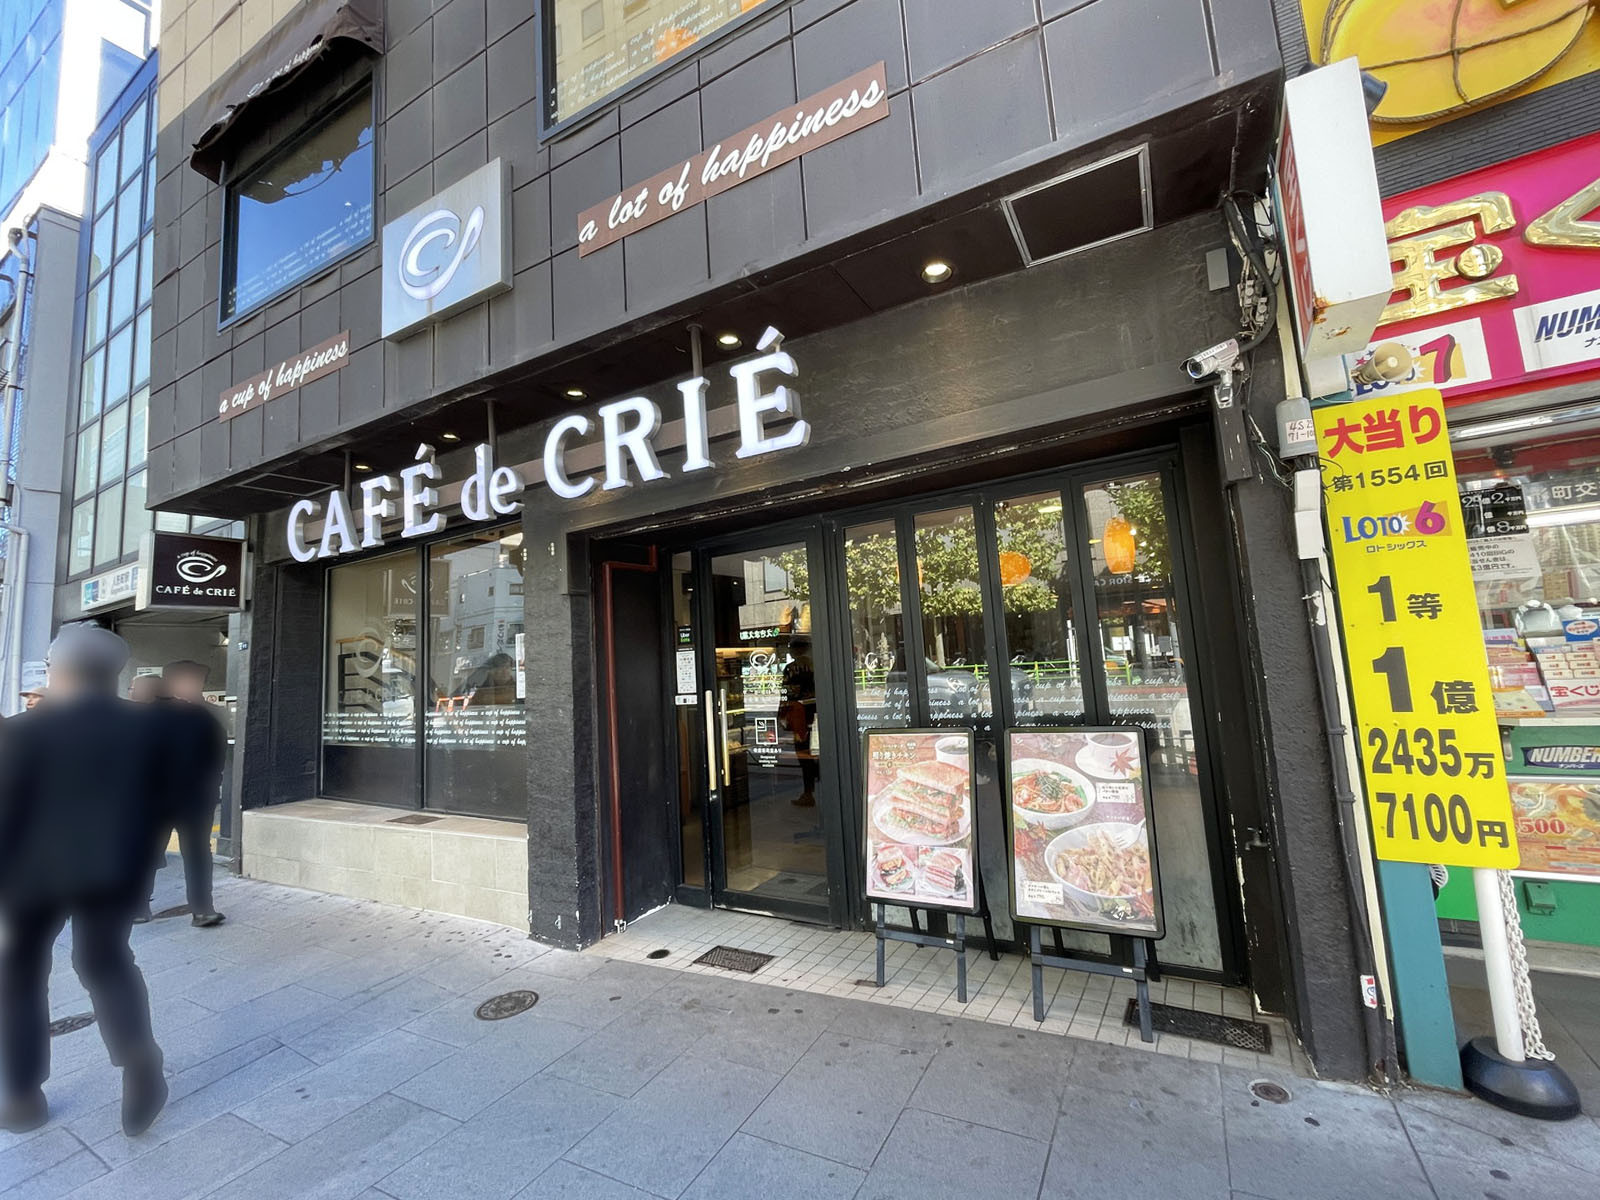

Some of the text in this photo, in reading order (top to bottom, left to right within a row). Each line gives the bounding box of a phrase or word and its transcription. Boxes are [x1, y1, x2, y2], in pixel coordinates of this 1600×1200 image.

[579, 79, 885, 243] a lot of happiness
[219, 340, 348, 413] a cup of happiness
[287, 325, 811, 563] CAFÉ de CRIÉ
[1324, 405, 1441, 459] 大当り
[1332, 460, 1449, 493] 第1554回
[1341, 500, 1445, 543] LOTO 6
[156, 584, 191, 595] CAFÉ
[206, 587, 237, 597] CRIÉ
[1056, 680, 1066, 691] of
[1145, 677, 1163, 687] cup
[1169, 675, 1181, 686] of
[1368, 727, 1495, 779] 2435万
[1376, 792, 1510, 849] 7100円
